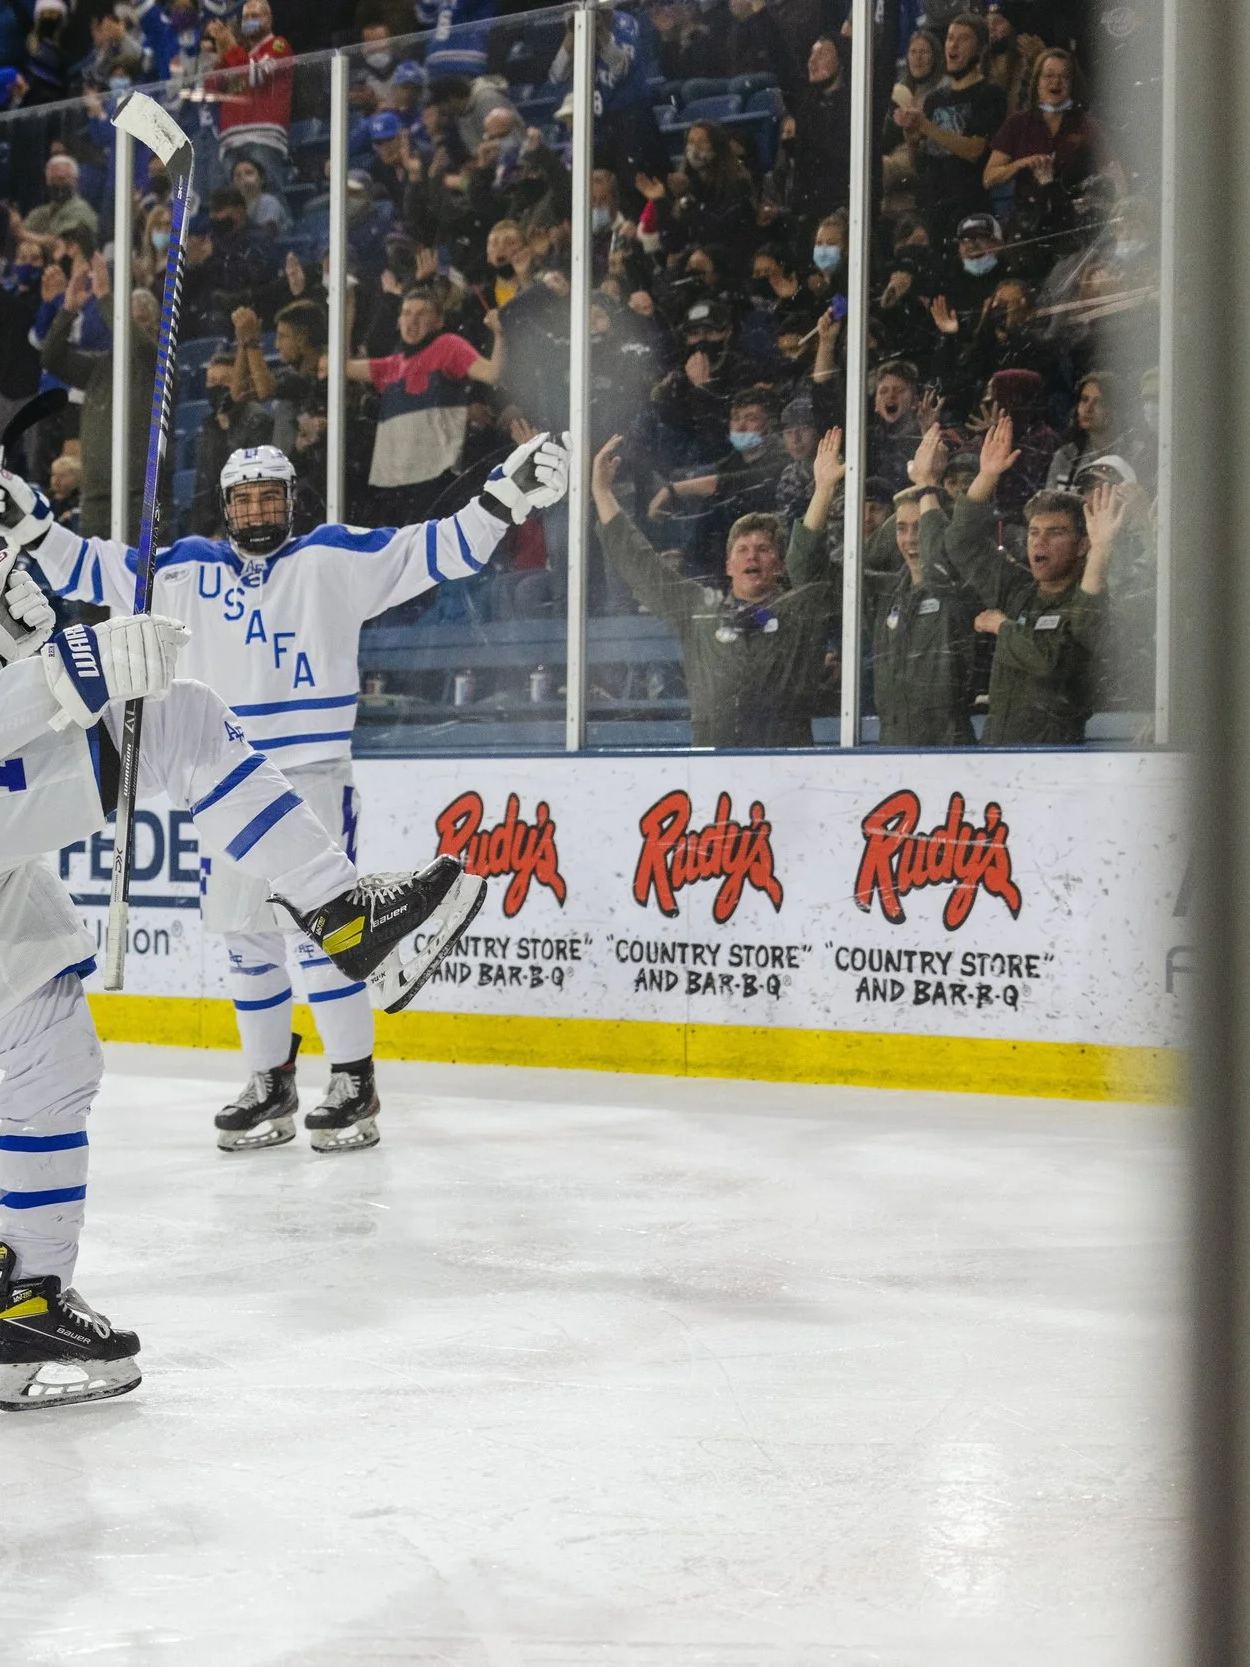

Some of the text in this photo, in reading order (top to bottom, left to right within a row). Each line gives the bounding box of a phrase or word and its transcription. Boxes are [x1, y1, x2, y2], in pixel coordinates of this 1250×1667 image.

[124, 743, 132, 797] WARRIOR
[435, 790, 567, 919] Rudy's
[632, 789, 784, 924] Rudy's
[854, 789, 1023, 932] Rudy's
[372, 904, 409, 929] BAUER
[431, 961, 472, 986] AND
[634, 969, 688, 993] AND
[855, 976, 905, 1003] AND
[56, 1327, 92, 1345] BAUER
